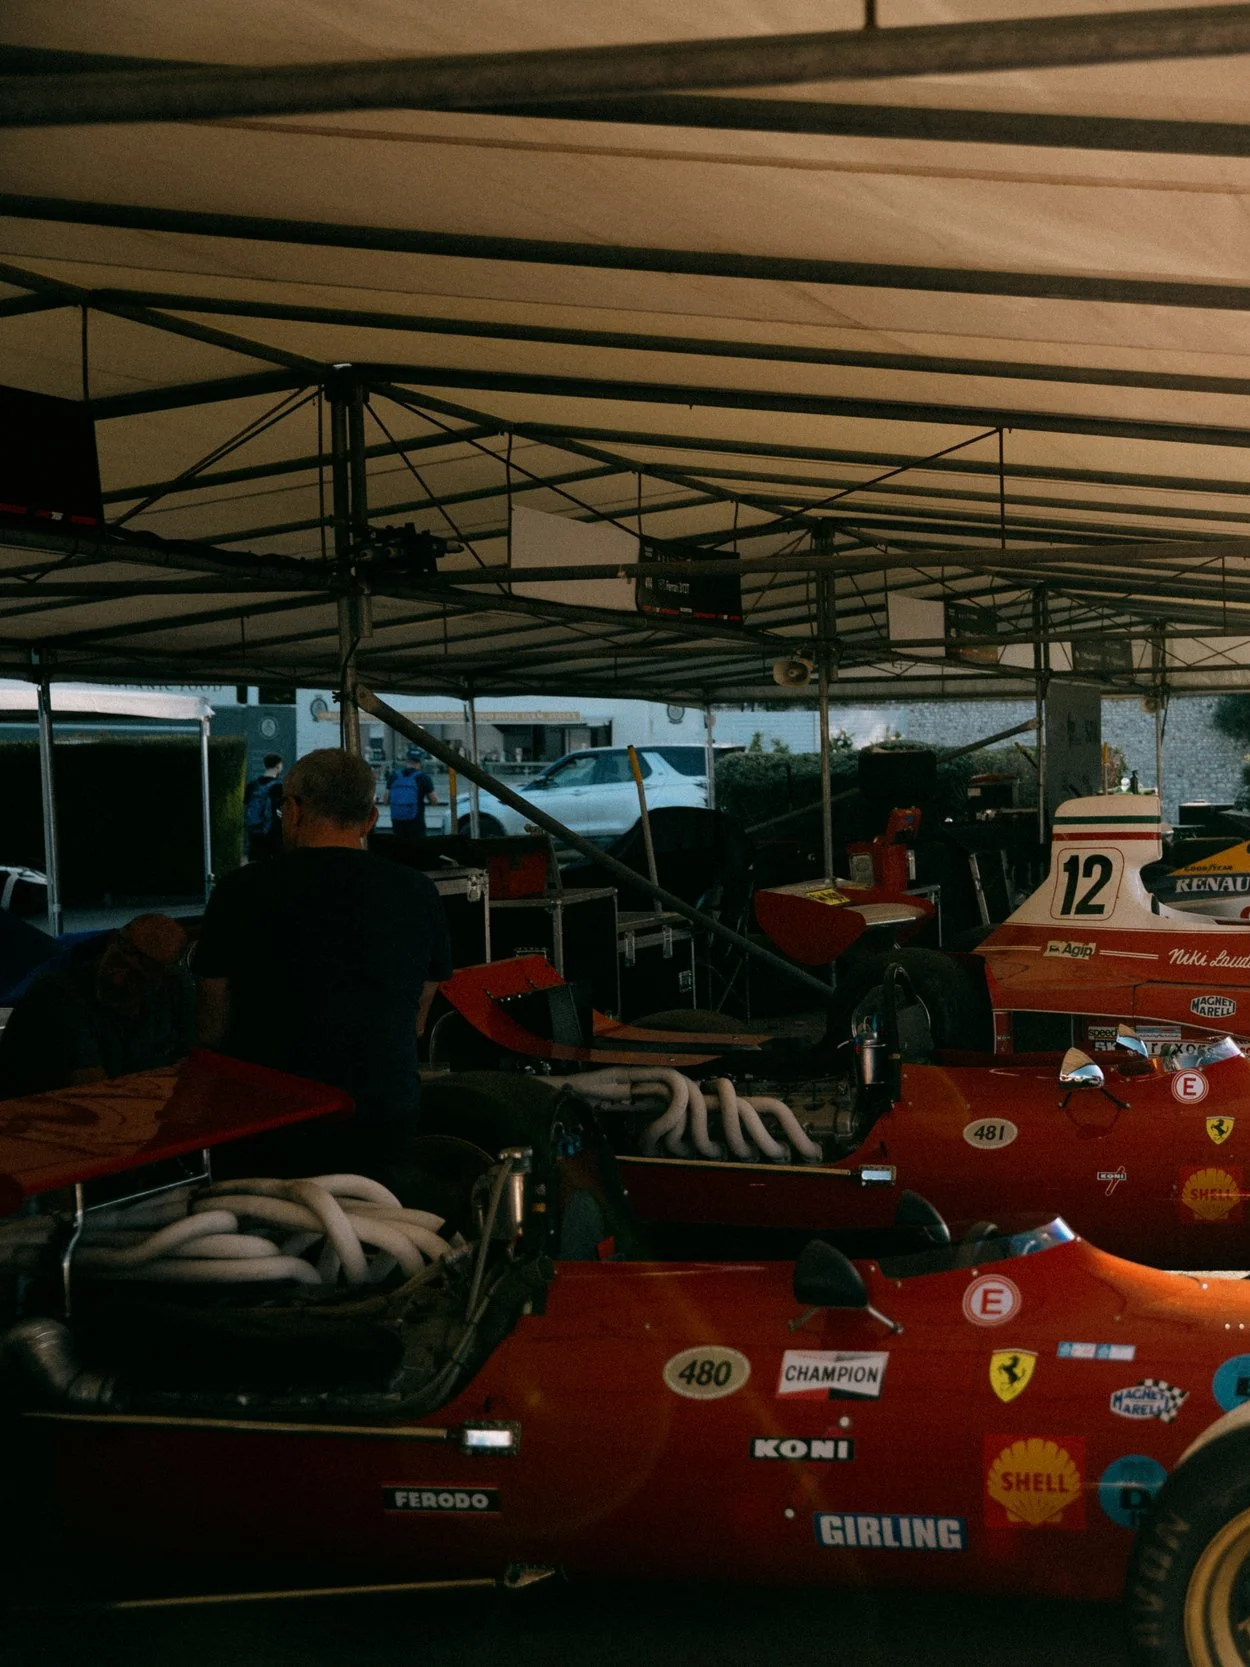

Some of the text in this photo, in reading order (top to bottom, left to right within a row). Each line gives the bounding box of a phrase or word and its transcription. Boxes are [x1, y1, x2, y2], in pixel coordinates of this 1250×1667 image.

[1060, 854, 1113, 914] 12
[1062, 942, 1093, 957] Agip
[1168, 948, 1207, 967] Niki
[1184, 1078, 1196, 1095] E
[974, 1122, 1006, 1142] 481
[1190, 1188, 1233, 1201] SHELL
[981, 1290, 1003, 1313] E
[679, 1361, 729, 1385] 480
[784, 1365, 878, 1384] CHAMPION
[754, 1440, 848, 1458] KONI
[1001, 1470, 1069, 1494] SHELL
[394, 1491, 488, 1508] FERODO
[821, 1515, 963, 1549] GIRLING
